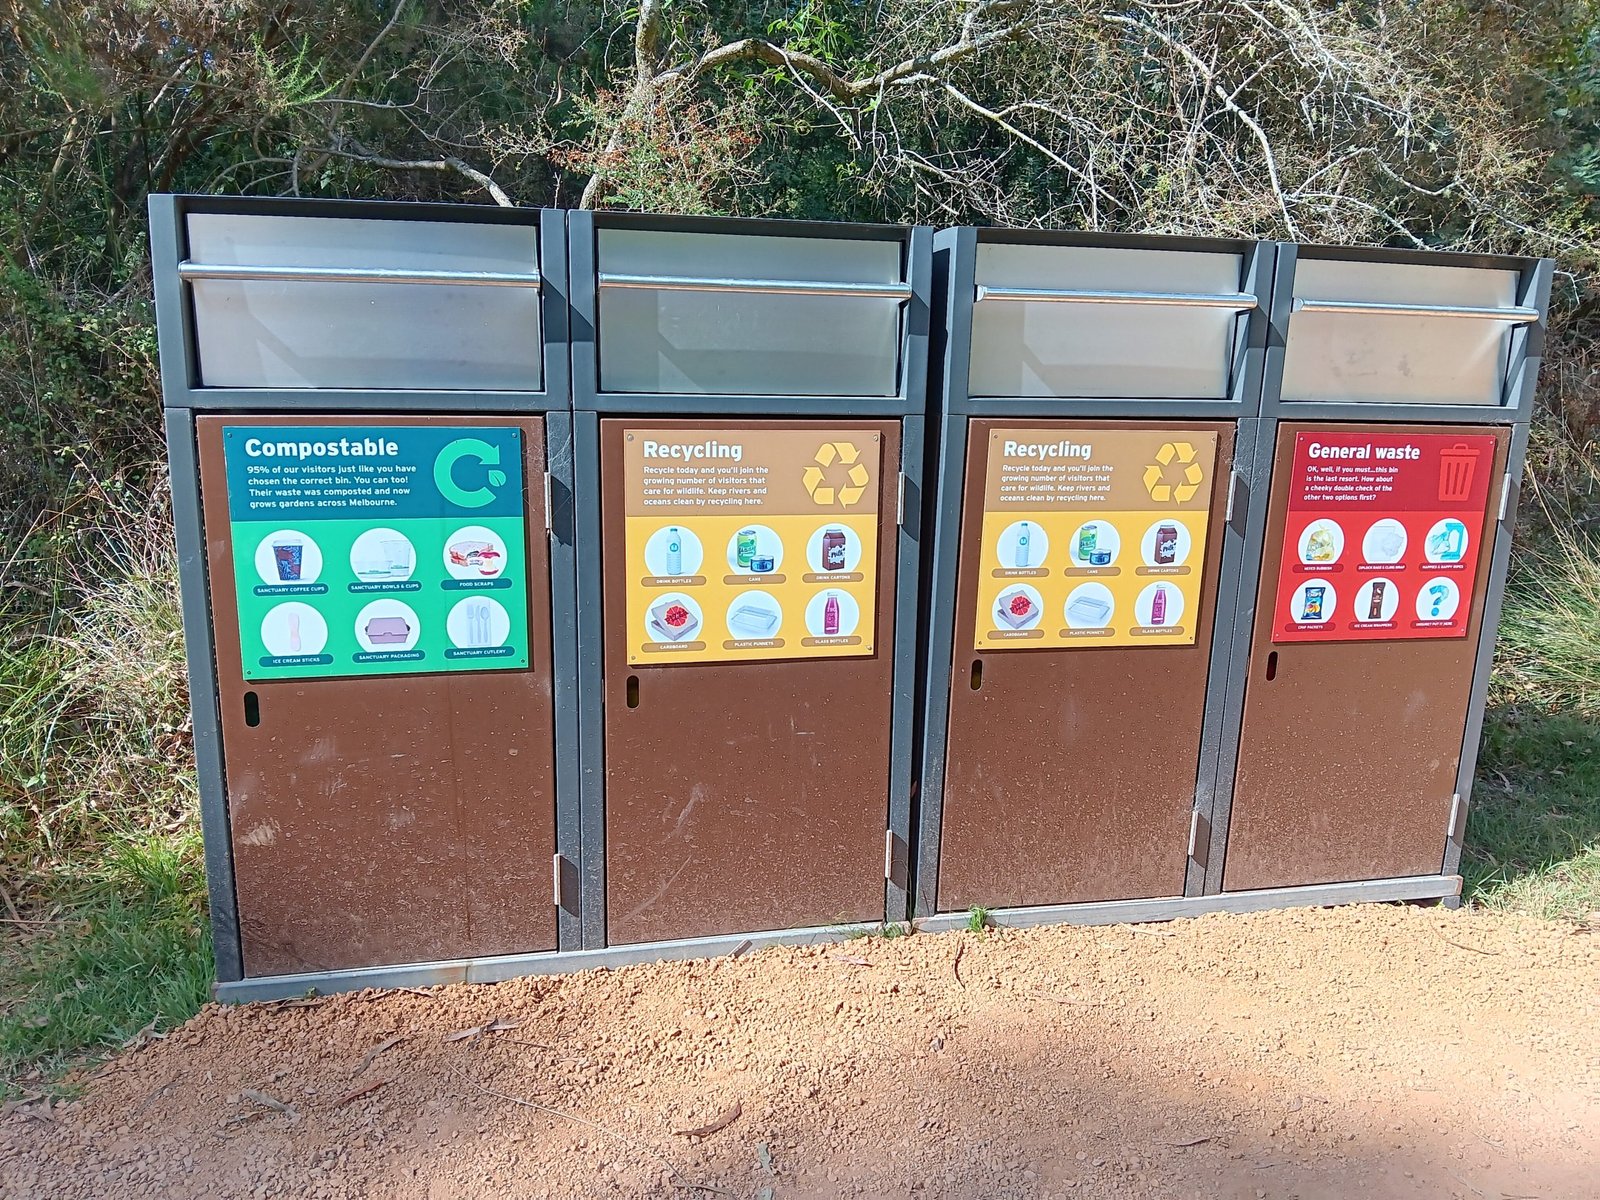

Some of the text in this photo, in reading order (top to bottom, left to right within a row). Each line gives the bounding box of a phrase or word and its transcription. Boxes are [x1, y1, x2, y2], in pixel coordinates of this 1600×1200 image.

[245, 438, 398, 460] Compostable
[643, 441, 742, 461] Recycling
[1004, 441, 1092, 460] Recycling
[1309, 443, 1420, 459] General waste
[247, 466, 269, 474] 95%
[302, 465, 336, 473] visitors
[338, 465, 356, 474] just
[377, 466, 393, 474] you
[644, 467, 674, 475] Recycle
[676, 467, 698, 475] today
[282, 477, 298, 485] the
[300, 477, 332, 485] correct
[335, 476, 351, 484] bin.
[354, 476, 370, 484] You
[391, 476, 408, 484] too!
[644, 477, 674, 485] growing
[323, 488, 372, 496] composted
[374, 487, 390, 495] and
[250, 501, 277, 509] grows
[279, 500, 315, 509] gardens
[696, 498, 705, 506] by
[708, 498, 742, 506] recycling
